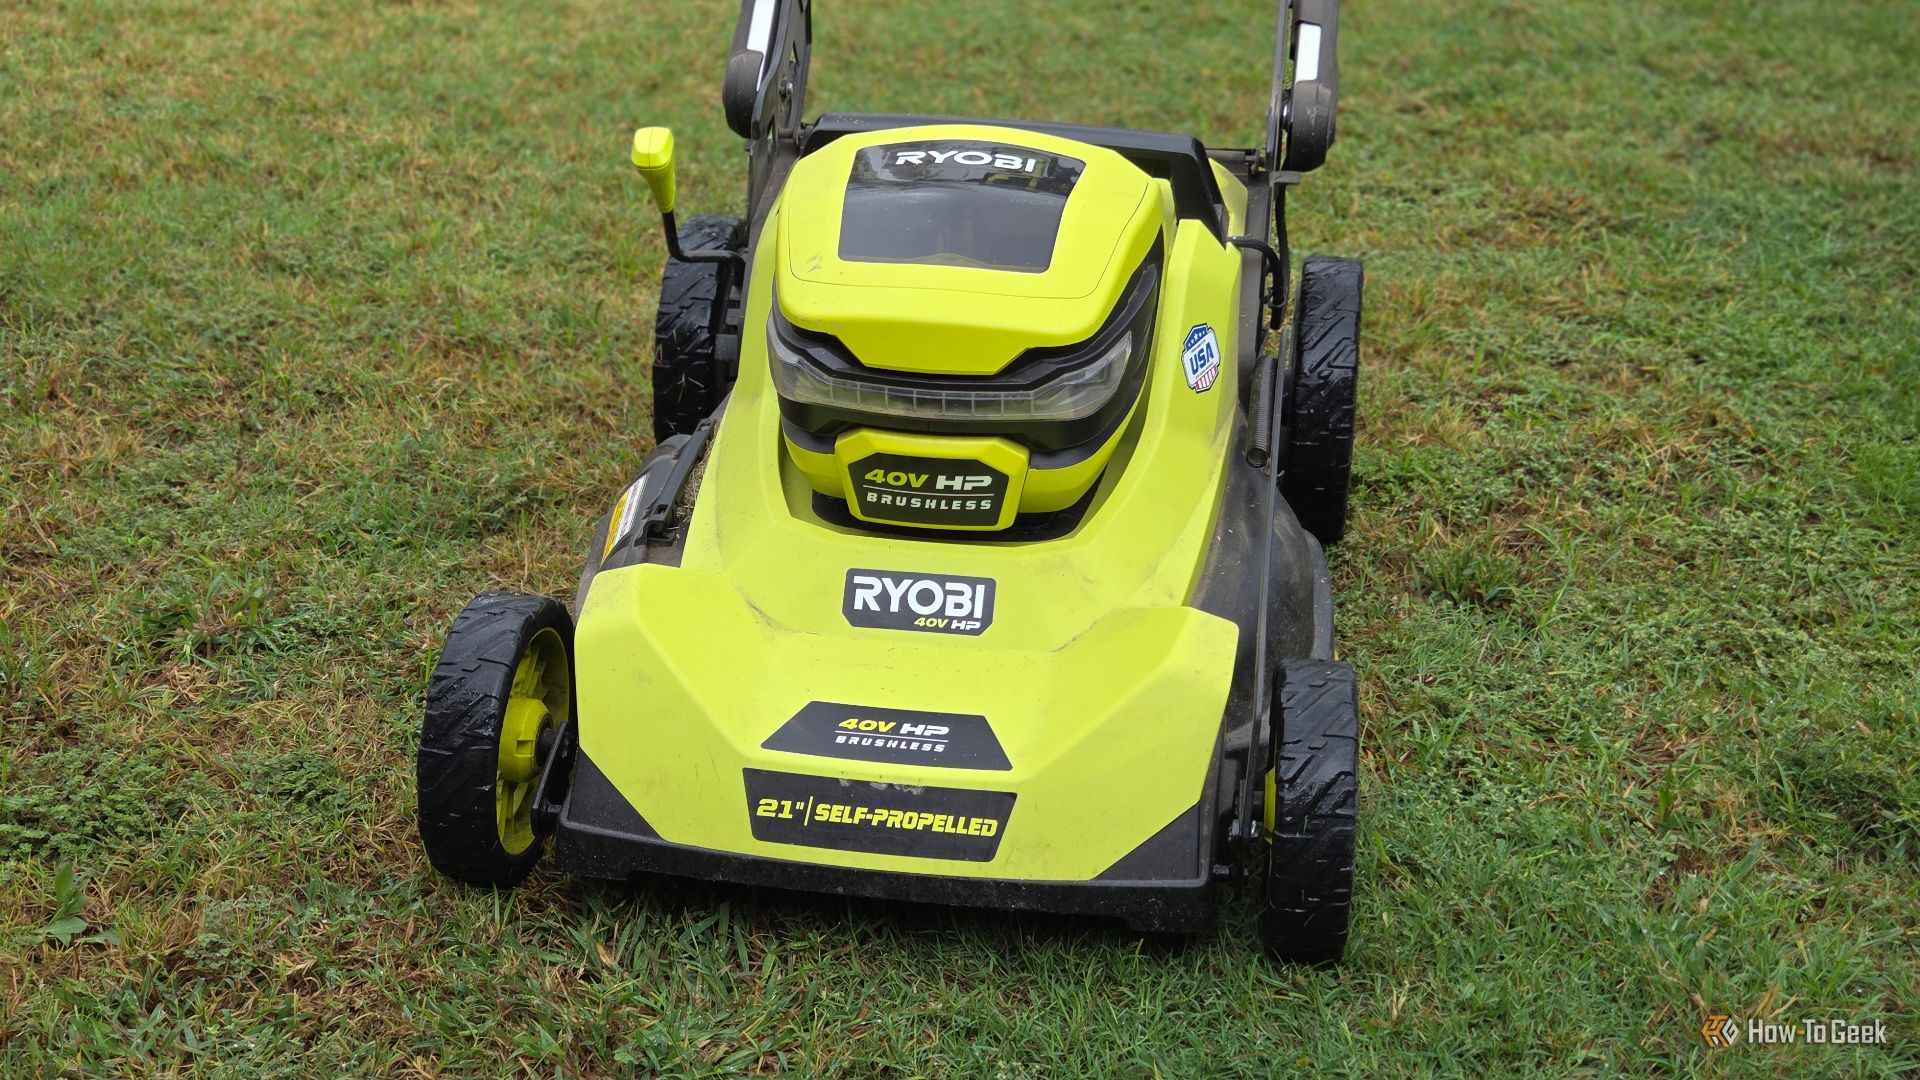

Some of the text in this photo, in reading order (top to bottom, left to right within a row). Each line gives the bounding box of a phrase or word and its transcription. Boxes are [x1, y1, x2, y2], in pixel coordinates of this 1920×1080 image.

[895, 150, 1036, 173] RYOBI
[1189, 341, 1215, 376] USA
[864, 468, 993, 491] 40V HP
[866, 491, 992, 510] BRUSHLESS
[853, 575, 986, 619] RYOBI
[914, 617, 981, 631] 40V HP
[838, 718, 950, 736] 40V HP
[835, 735, 946, 753] BRUSHLESS
[814, 803, 999, 837] SELF-PROPELLED
